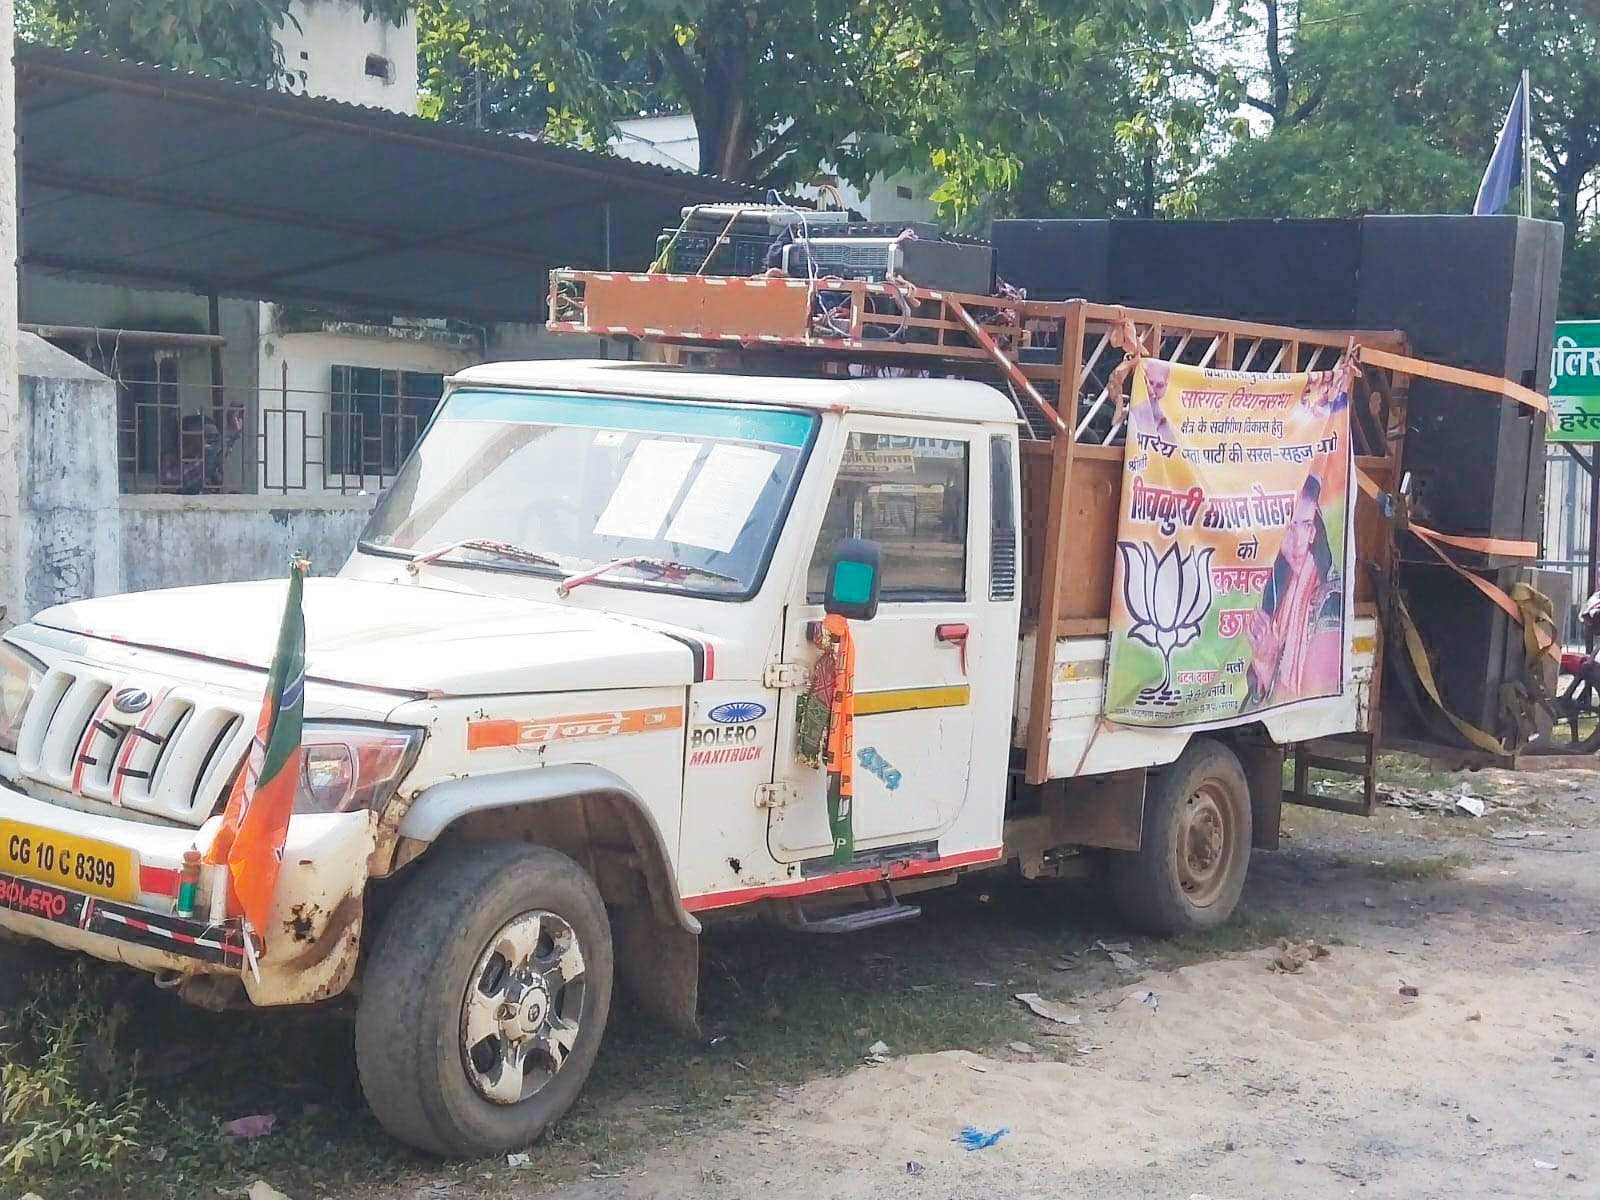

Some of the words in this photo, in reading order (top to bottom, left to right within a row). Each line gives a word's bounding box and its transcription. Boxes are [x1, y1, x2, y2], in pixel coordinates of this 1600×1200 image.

[1229, 387, 1295, 410] विधानसभा
[1197, 417, 1208, 433] के
[1271, 417, 1284, 439] हेतु
[1203, 442, 1225, 465] पार्टी
[1228, 443, 1243, 465] की
[1253, 486, 1296, 528] चौहान
[1236, 534, 1259, 560] को
[690, 725, 757, 748] BOLERO
[690, 745, 763, 767] MAXITRUCK
[9, 834, 32, 865] CG
[36, 841, 54, 872] 10
[59, 849, 71, 876] C
[75, 852, 116, 888] 8399
[0, 879, 68, 919] BOLERO
